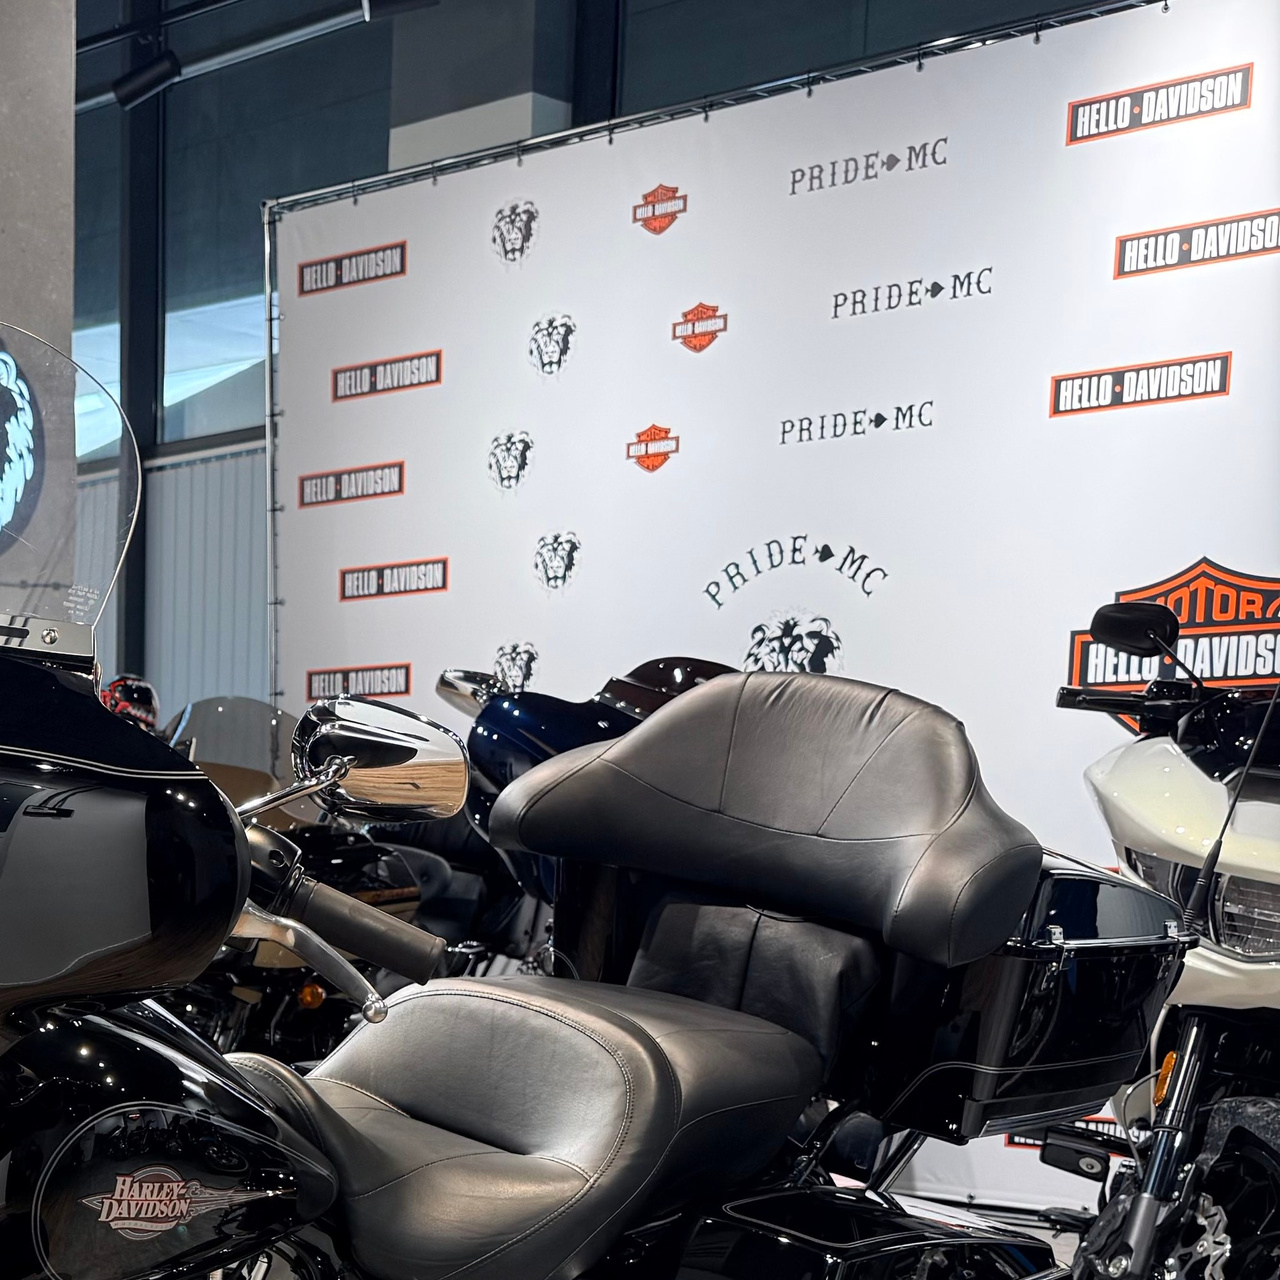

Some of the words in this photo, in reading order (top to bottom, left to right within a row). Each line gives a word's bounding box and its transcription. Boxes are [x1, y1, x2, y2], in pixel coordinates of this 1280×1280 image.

[1076, 97, 1131, 138] HELLO
[1141, 72, 1243, 124] DAVIDSON
[789, 151, 879, 196] PRIDE
[905, 137, 948, 172] MC
[1123, 232, 1180, 272] HELLO
[1190, 215, 1280, 262] DAVIDSO
[303, 262, 337, 292] HELLO
[341, 247, 402, 284] DAVIDSON
[831, 277, 923, 319] PRIDE
[949, 266, 993, 300] MC
[337, 368, 371, 397] HELLO
[376, 355, 437, 391] DAVIDSON
[1059, 375, 1112, 411] HELLO
[1122, 359, 1221, 403] DAVIDSON
[779, 409, 868, 445] PRIDE
[893, 400, 934, 430] MC
[303, 476, 336, 504] HELLO
[341, 466, 400, 499] DAVIDSON
[344, 570, 378, 598] HELLO
[383, 562, 444, 593] DAVIDSON
[703, 534, 808, 610] PRIDE
[835, 545, 889, 598] MC
[1155, 576, 1263, 625] OTOR
[311, 672, 344, 697] HELLO
[349, 666, 407, 695] DAVIDSON
[98, 1198, 191, 1222] DAVIDSON
